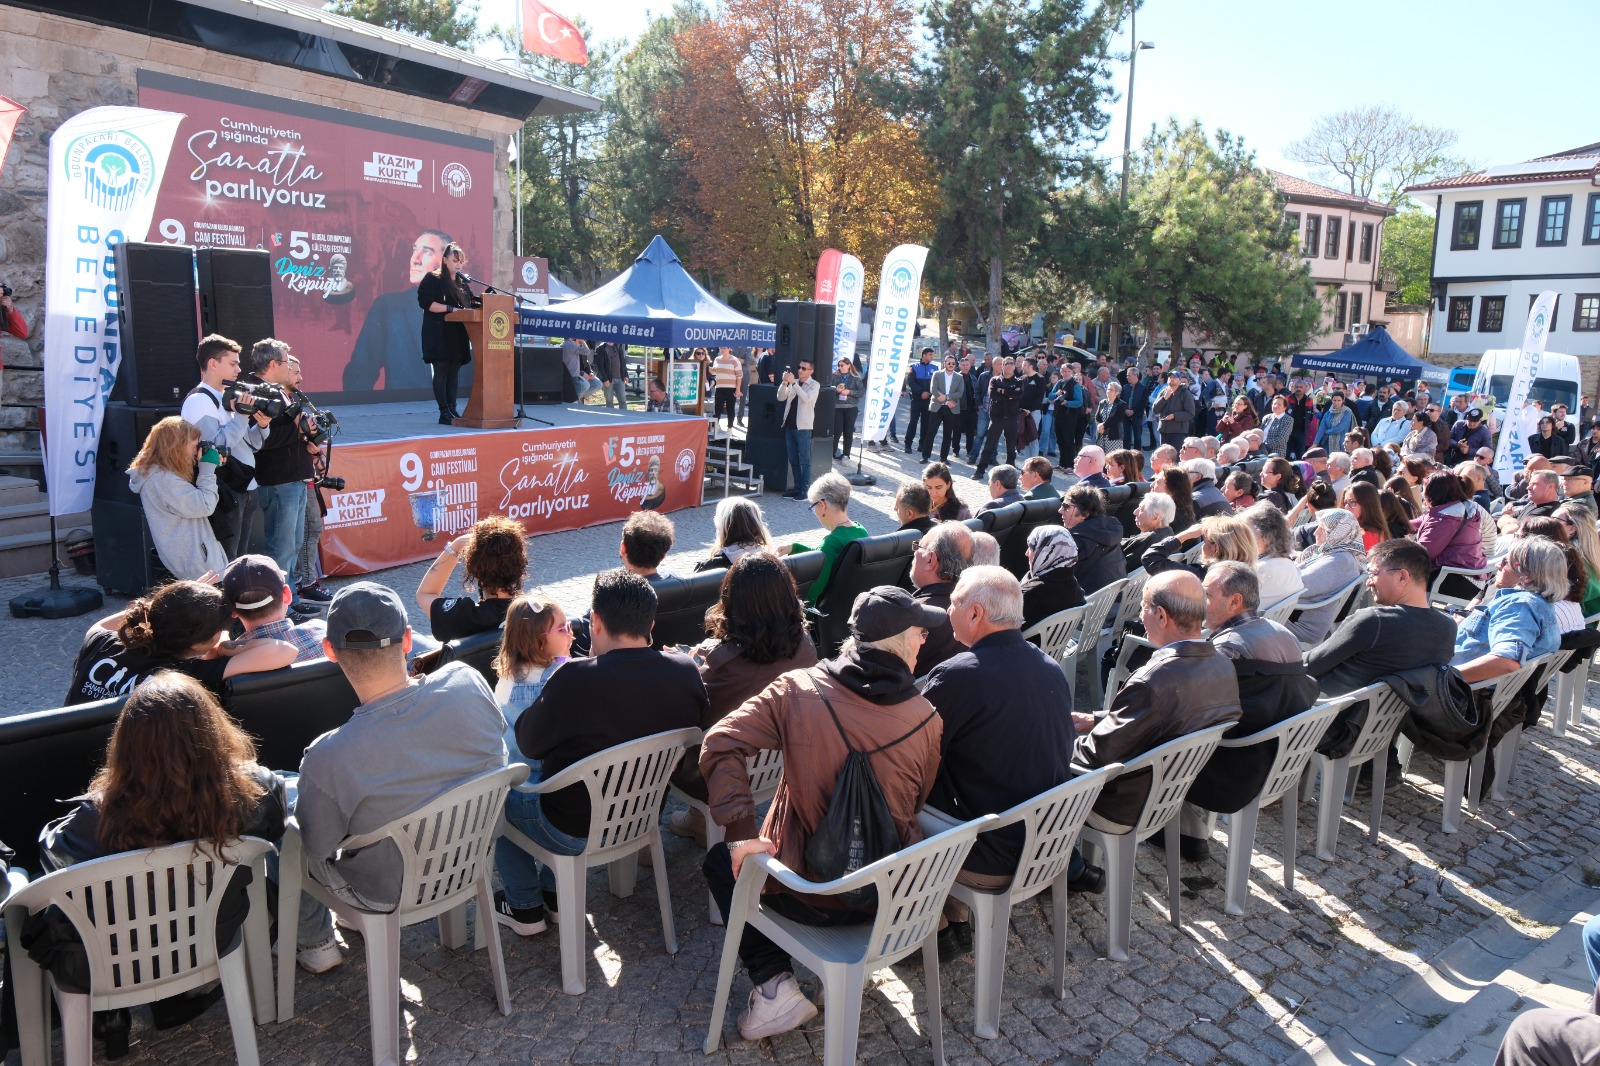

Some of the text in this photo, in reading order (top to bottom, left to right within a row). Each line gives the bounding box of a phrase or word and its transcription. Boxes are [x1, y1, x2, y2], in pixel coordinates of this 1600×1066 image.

[220, 117, 301, 140] Cumhuriyetin
[221, 131, 269, 145] ışığında
[187, 129, 323, 187] Sanatta
[378, 155, 415, 170] KAZIM
[378, 167, 408, 180] KURT
[205, 179, 326, 208] parlıyoruz
[194, 231, 246, 246] CAM FESTİVALİ
[289, 231, 320, 260] 5.
[275, 257, 326, 276] Deniz
[281, 271, 343, 299] Köpüğü
[574, 319, 618, 334] Birlikte
[621, 324, 655, 338] Güzel
[684, 327, 748, 341] ODUNPAZARI
[73, 225, 99, 483] BELEDİYESİ
[868, 305, 894, 429] BELEDİYESİ
[878, 307, 909, 429] ODUNPAZARI
[1350, 363, 1383, 373] Birlikte
[521, 439, 577, 452] Cumhuriyetin
[619, 436, 640, 468] 5.
[430, 457, 478, 476] CAM FESTİVALİ
[522, 452, 554, 465] ışığında
[400, 452, 434, 492] 9.
[499, 452, 590, 510] Sanatta
[607, 467, 645, 487] Deniz
[336, 491, 378, 508] KAZIM
[435, 478, 478, 506] Camın
[611, 482, 658, 505] Köpüğü
[338, 505, 371, 521] KURT
[432, 502, 478, 535] Büyüsü
[508, 494, 590, 520] parlıyoruz
